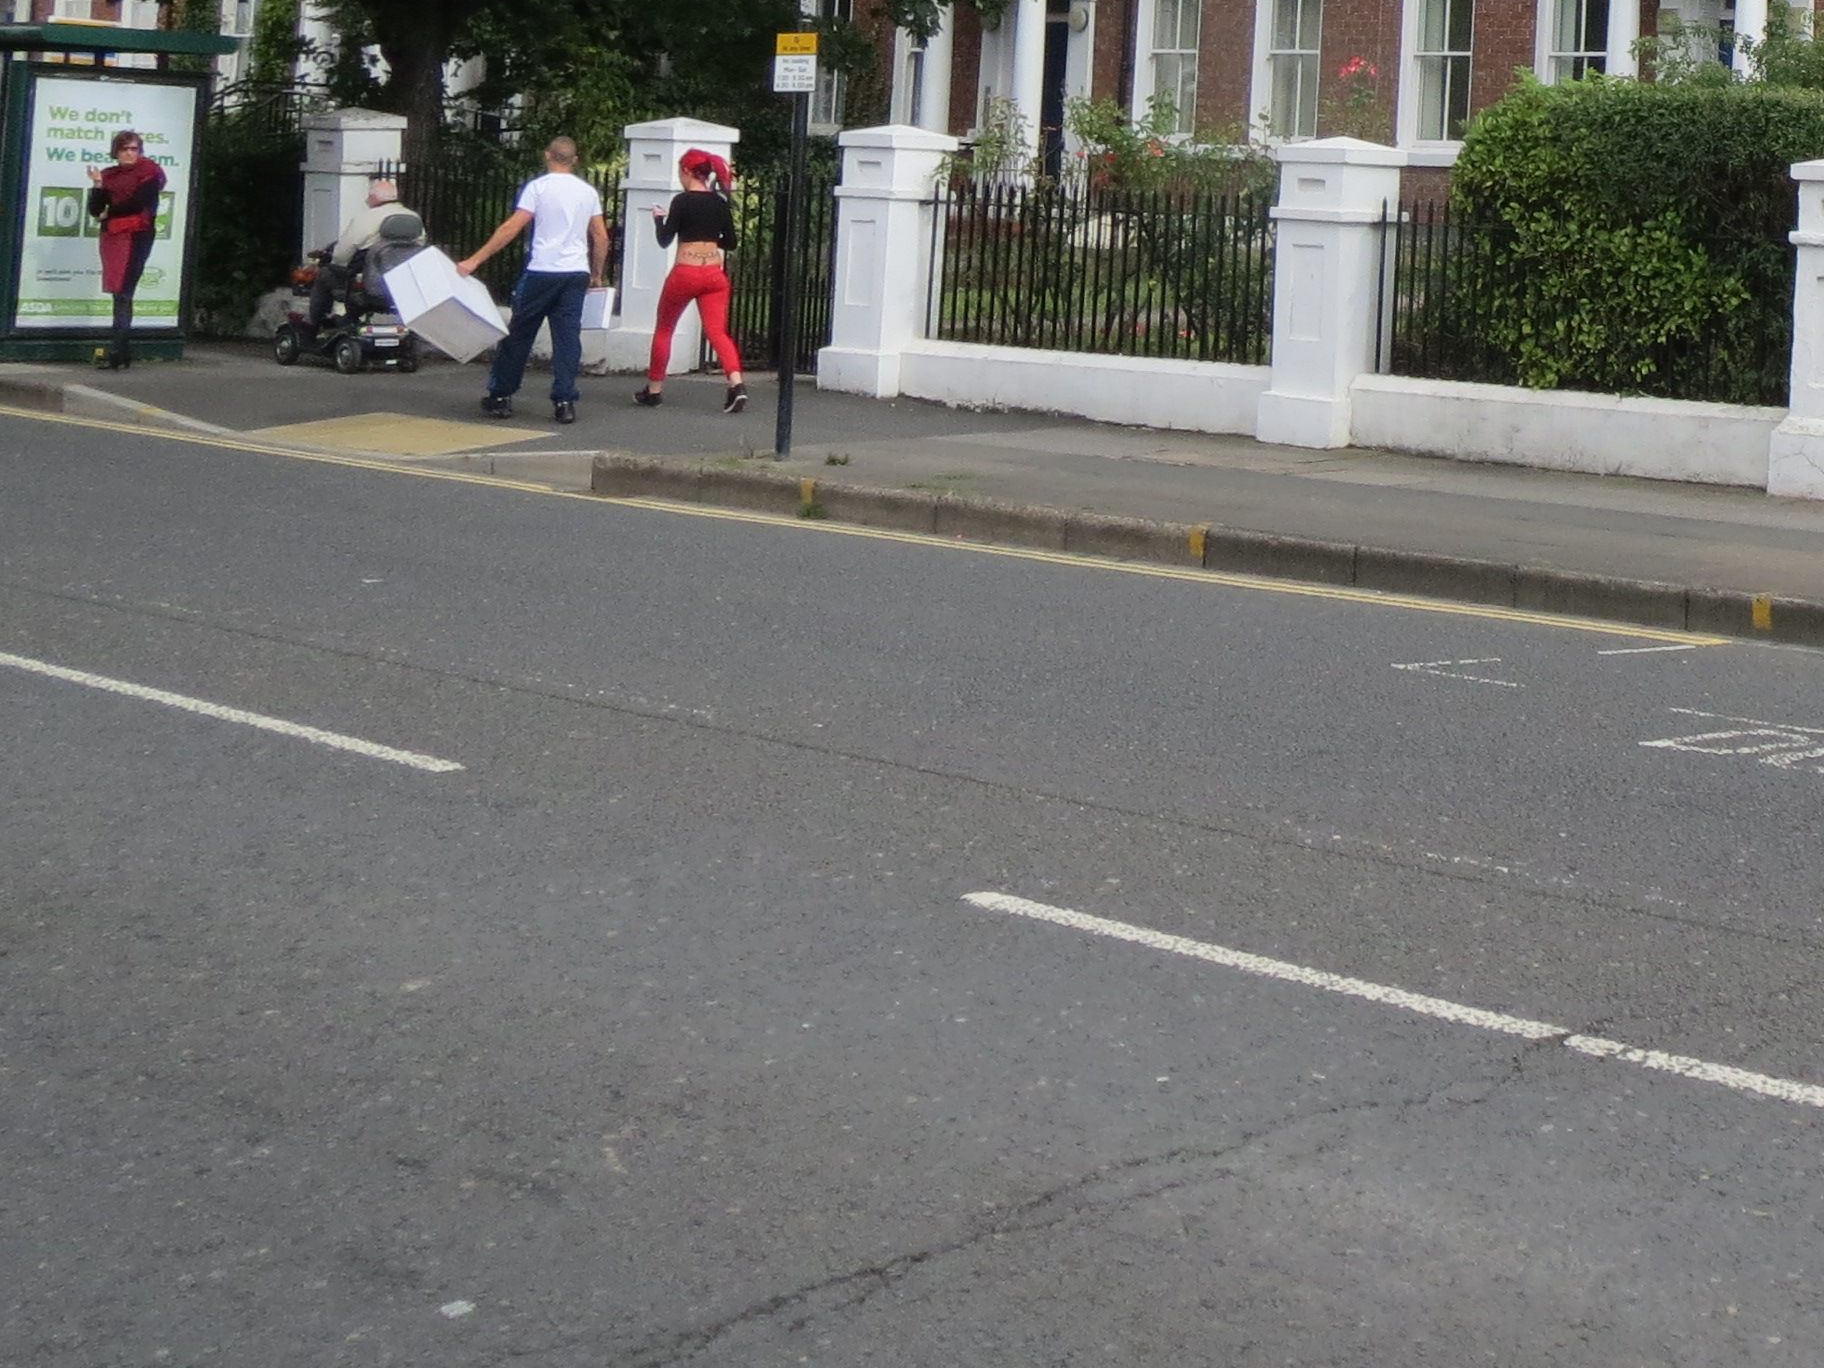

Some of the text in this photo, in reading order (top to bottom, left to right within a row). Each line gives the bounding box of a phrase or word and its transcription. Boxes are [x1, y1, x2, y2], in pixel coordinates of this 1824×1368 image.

[49, 105, 133, 124] We don't
[46, 126, 169, 146] match pces.
[46, 146, 77, 162] We
[81, 148, 117, 164] bea
[42, 196, 79, 228] 10
